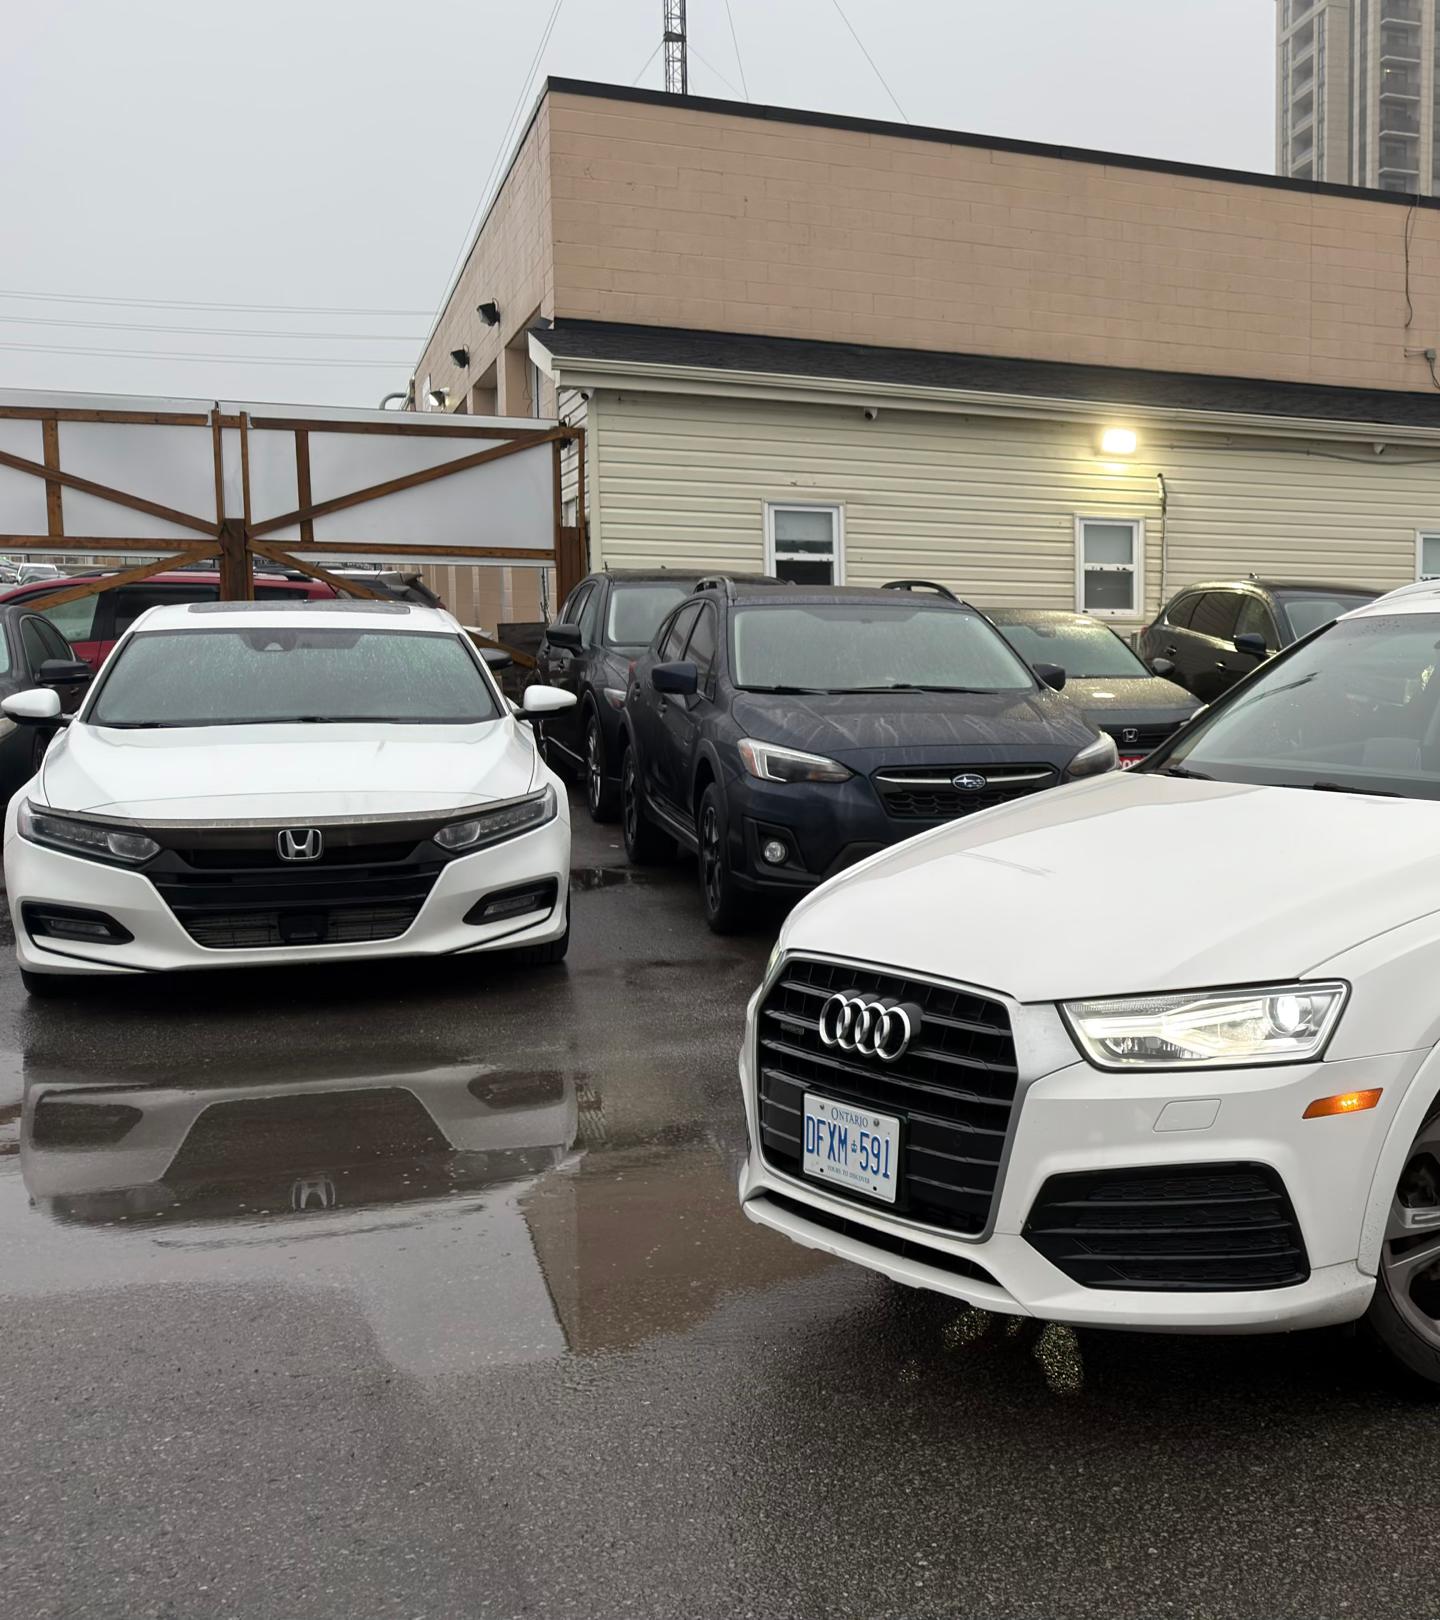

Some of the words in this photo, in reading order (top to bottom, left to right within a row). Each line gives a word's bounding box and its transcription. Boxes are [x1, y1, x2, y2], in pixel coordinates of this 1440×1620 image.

[831, 1106, 869, 1128] ONTARIO
[805, 1114, 848, 1166] DFXM
[859, 1130, 890, 1180] 591
